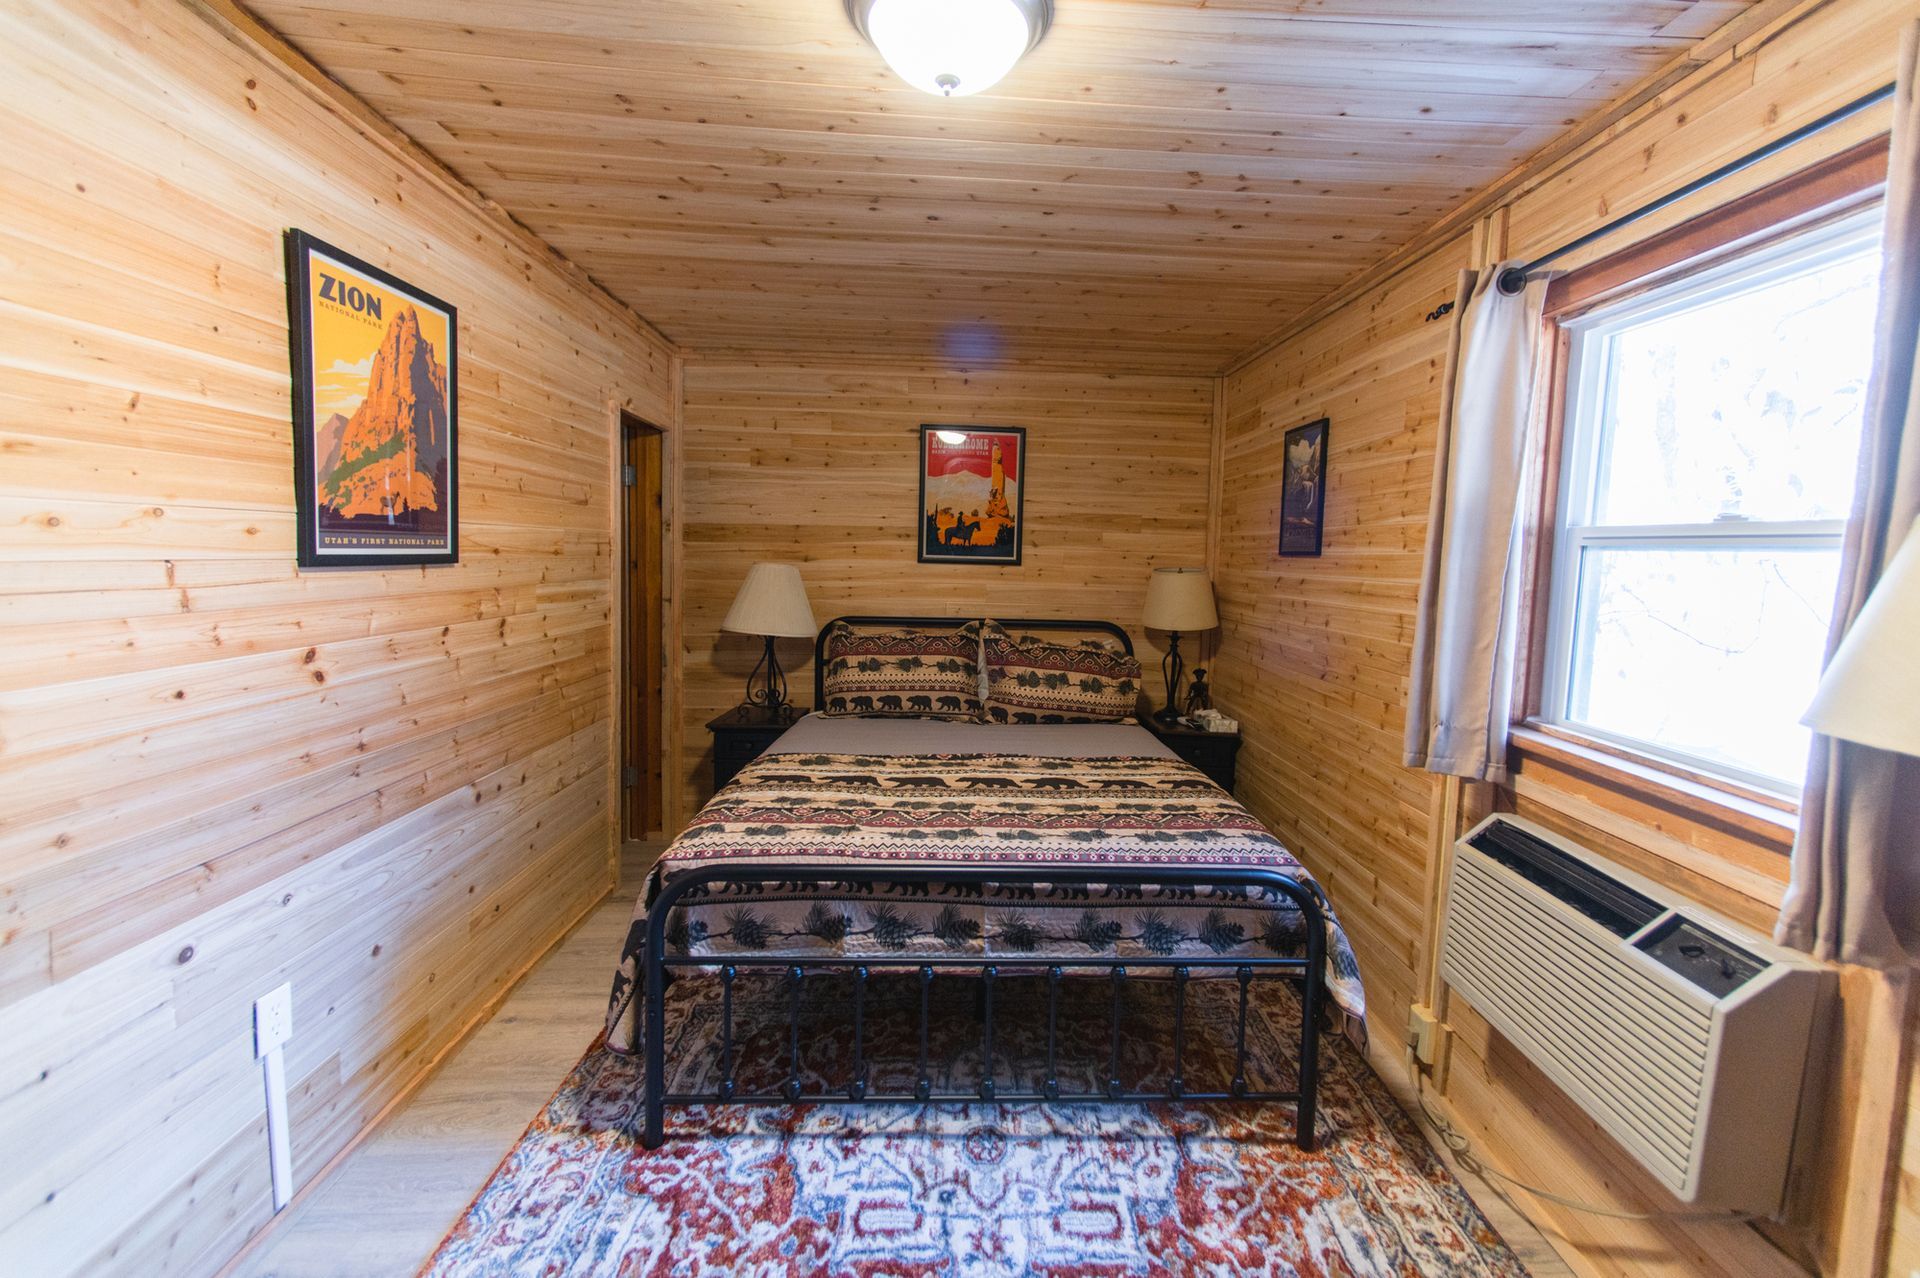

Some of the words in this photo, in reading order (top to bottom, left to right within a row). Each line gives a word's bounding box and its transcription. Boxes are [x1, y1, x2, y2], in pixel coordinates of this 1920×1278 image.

[319, 272, 382, 320] ZION
[319, 301, 360, 321] NATIONAL
[363, 318, 383, 330] PARK
